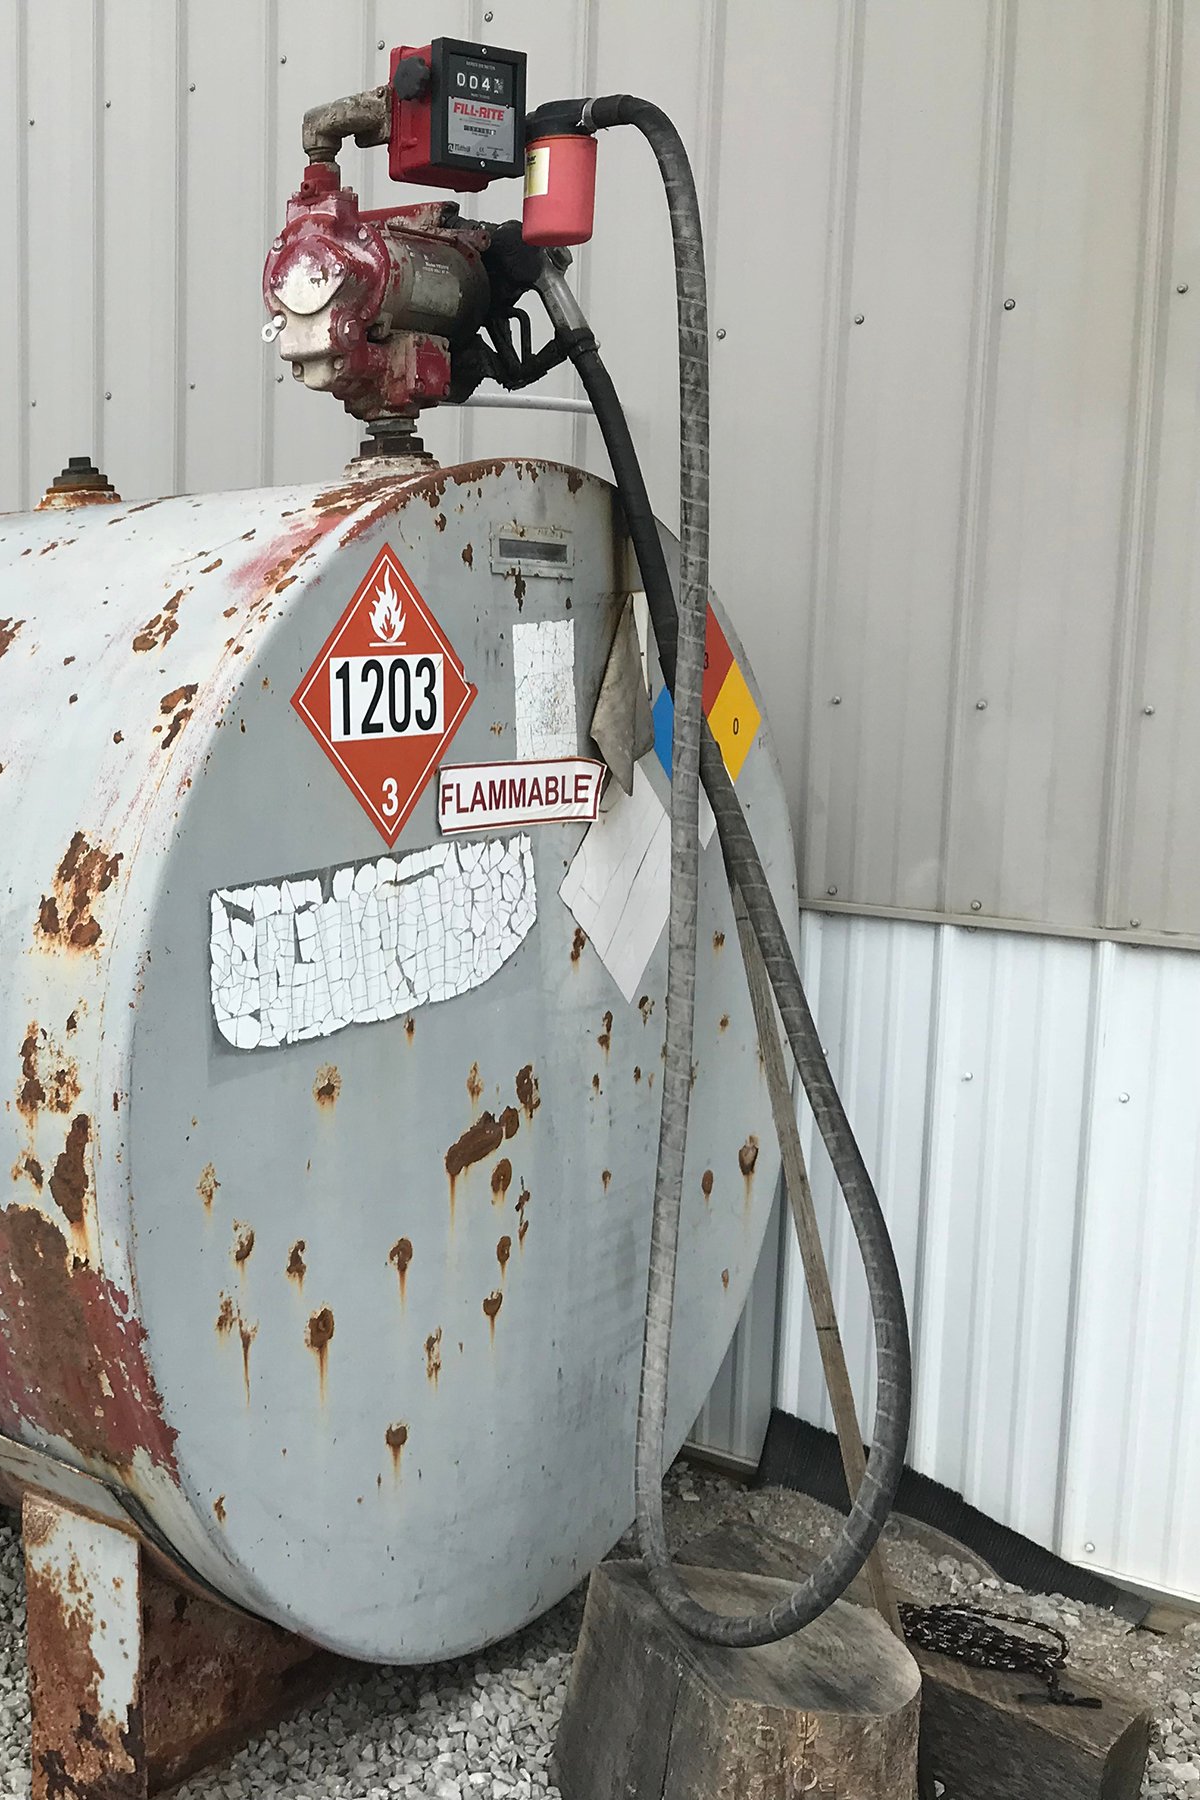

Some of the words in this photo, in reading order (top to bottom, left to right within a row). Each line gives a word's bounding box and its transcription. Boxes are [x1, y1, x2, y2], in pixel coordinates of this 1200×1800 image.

[453, 102, 505, 121] FILL-RITE
[335, 657, 437, 736] 1203
[732, 717, 739, 735] 0
[381, 777, 399, 816] 3
[441, 774, 593, 816] FLAMMABLE
